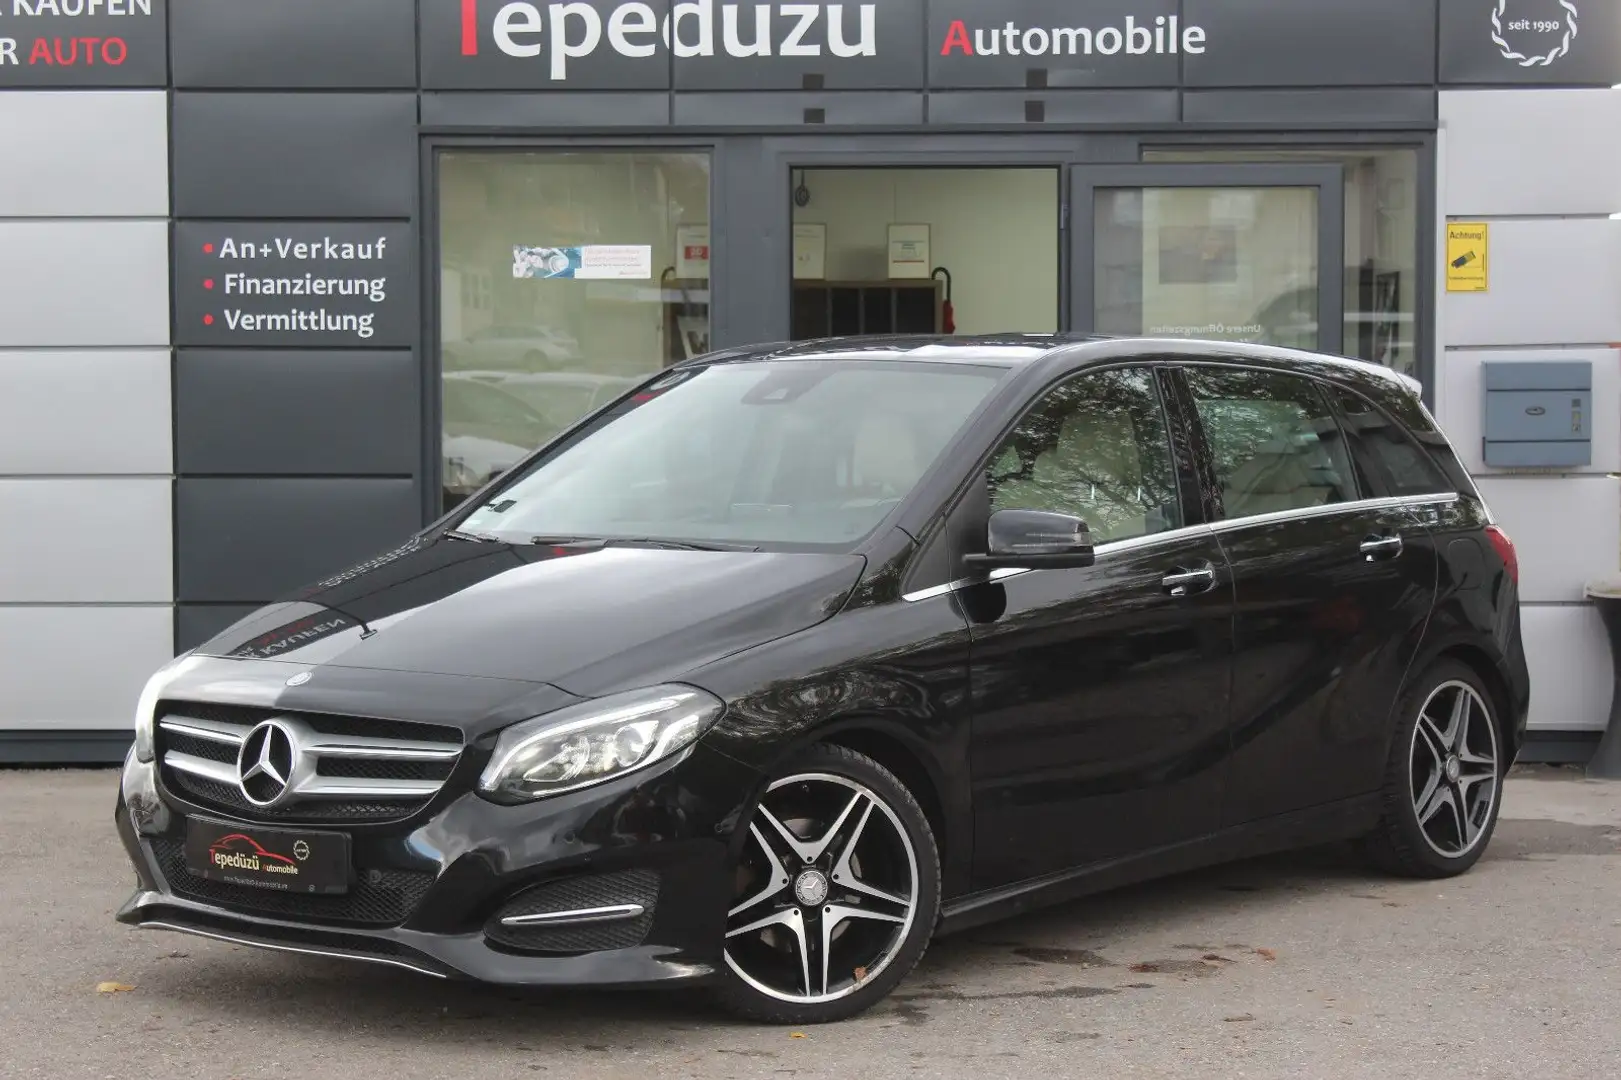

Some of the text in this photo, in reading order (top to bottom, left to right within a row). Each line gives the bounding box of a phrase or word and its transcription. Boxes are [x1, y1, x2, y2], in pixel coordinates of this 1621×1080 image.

[940, 15, 1206, 56] Automobile
[1508, 20, 1560, 33] seit 1990
[28, 36, 128, 66] AUTO
[219, 236, 386, 259] An+Verkauf
[225, 272, 386, 302] Finanzierung
[224, 308, 374, 338] Vermittlung
